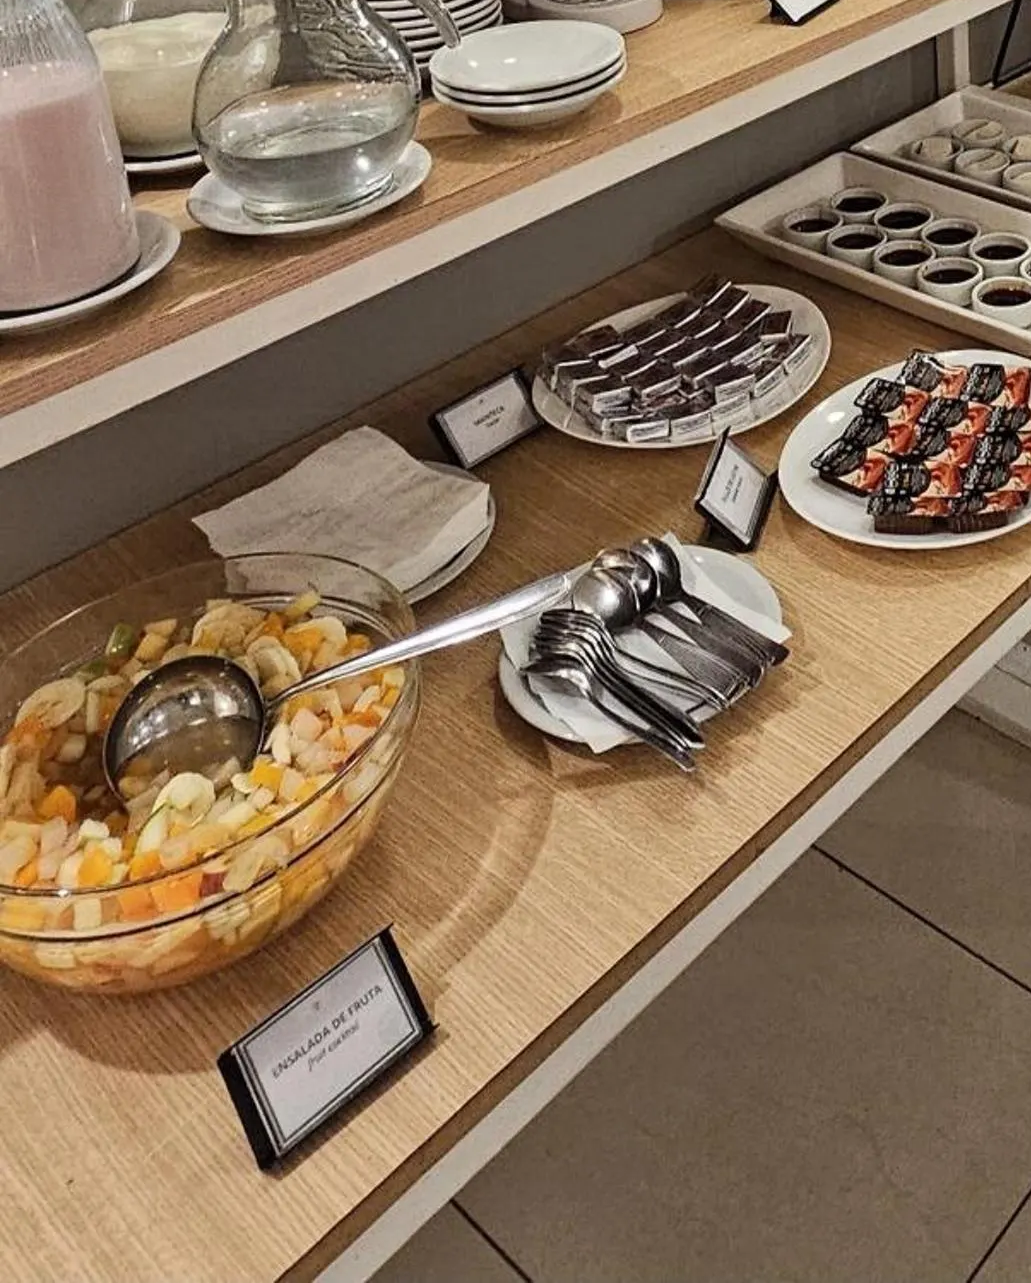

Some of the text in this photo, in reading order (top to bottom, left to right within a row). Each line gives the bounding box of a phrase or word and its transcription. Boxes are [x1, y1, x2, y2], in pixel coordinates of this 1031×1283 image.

[272, 984, 382, 1078] ENSALADA DE FRUTA
